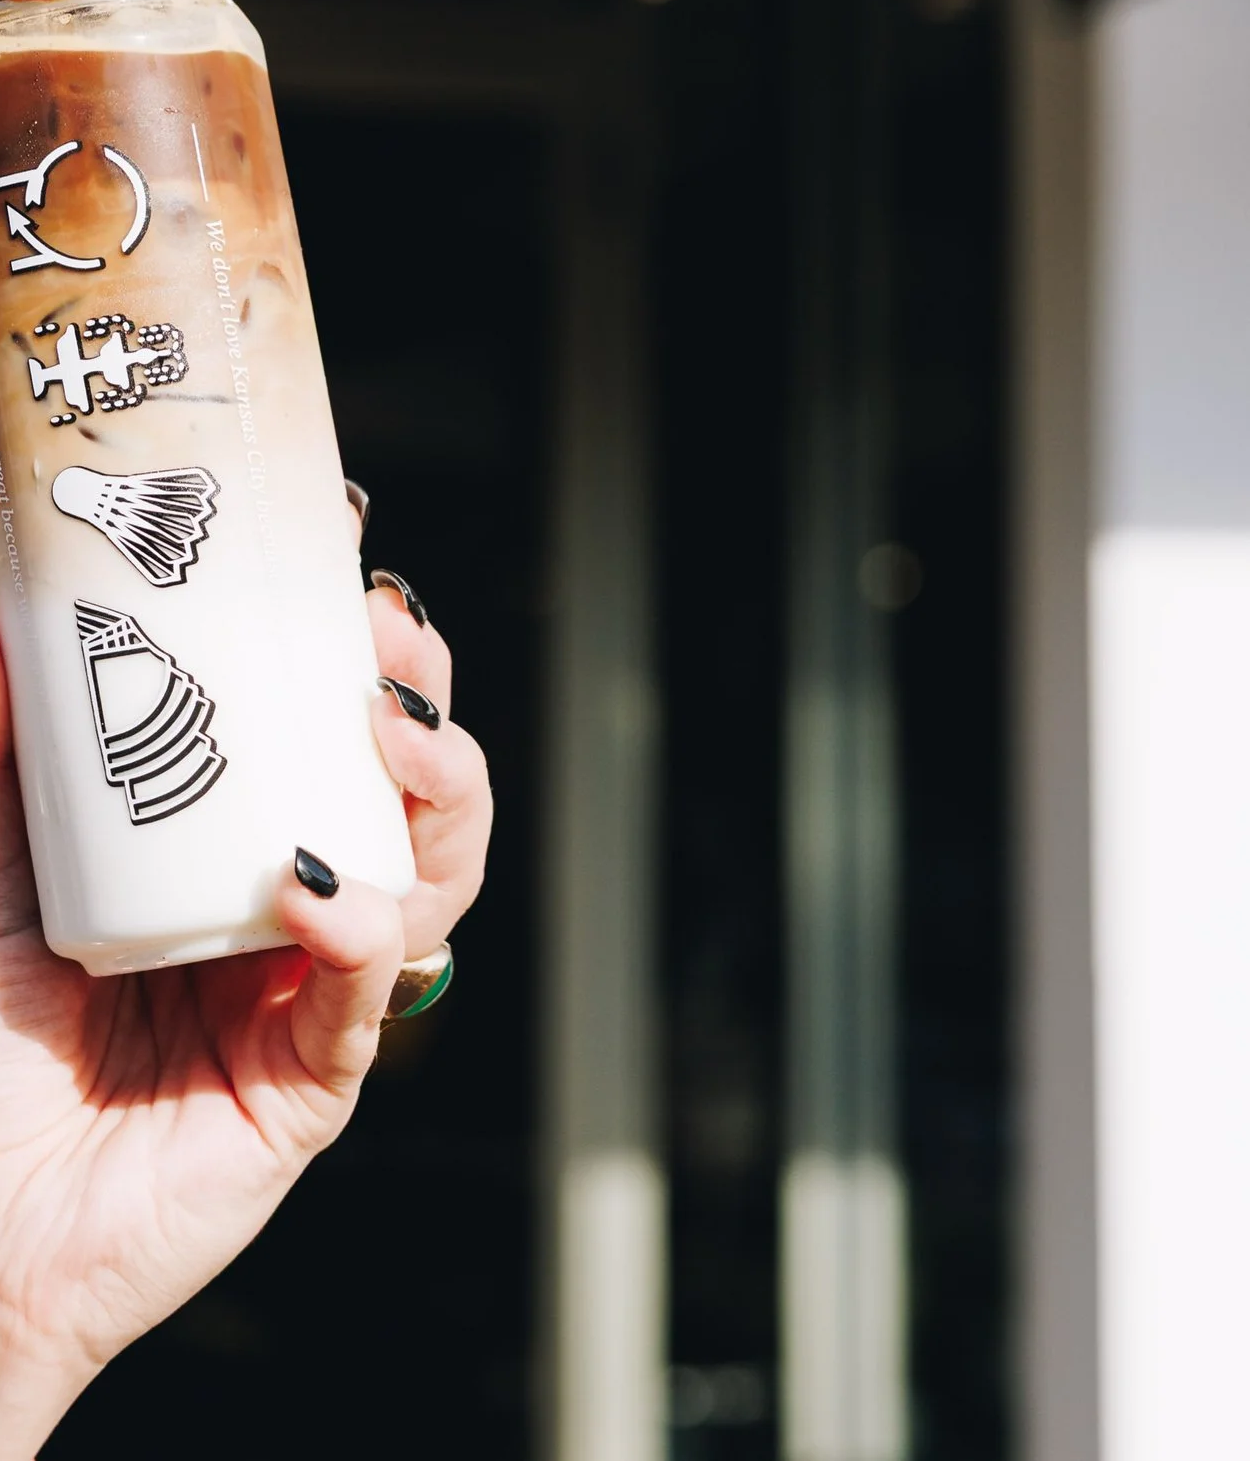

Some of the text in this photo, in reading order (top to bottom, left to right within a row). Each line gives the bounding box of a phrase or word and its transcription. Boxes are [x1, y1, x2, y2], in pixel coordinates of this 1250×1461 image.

[205, 218, 227, 253] We
[212, 256, 239, 315] don't
[223, 316, 243, 360] love
[230, 364, 258, 445] Kansas
[246, 449, 267, 496] City
[0, 508, 25, 593] because
